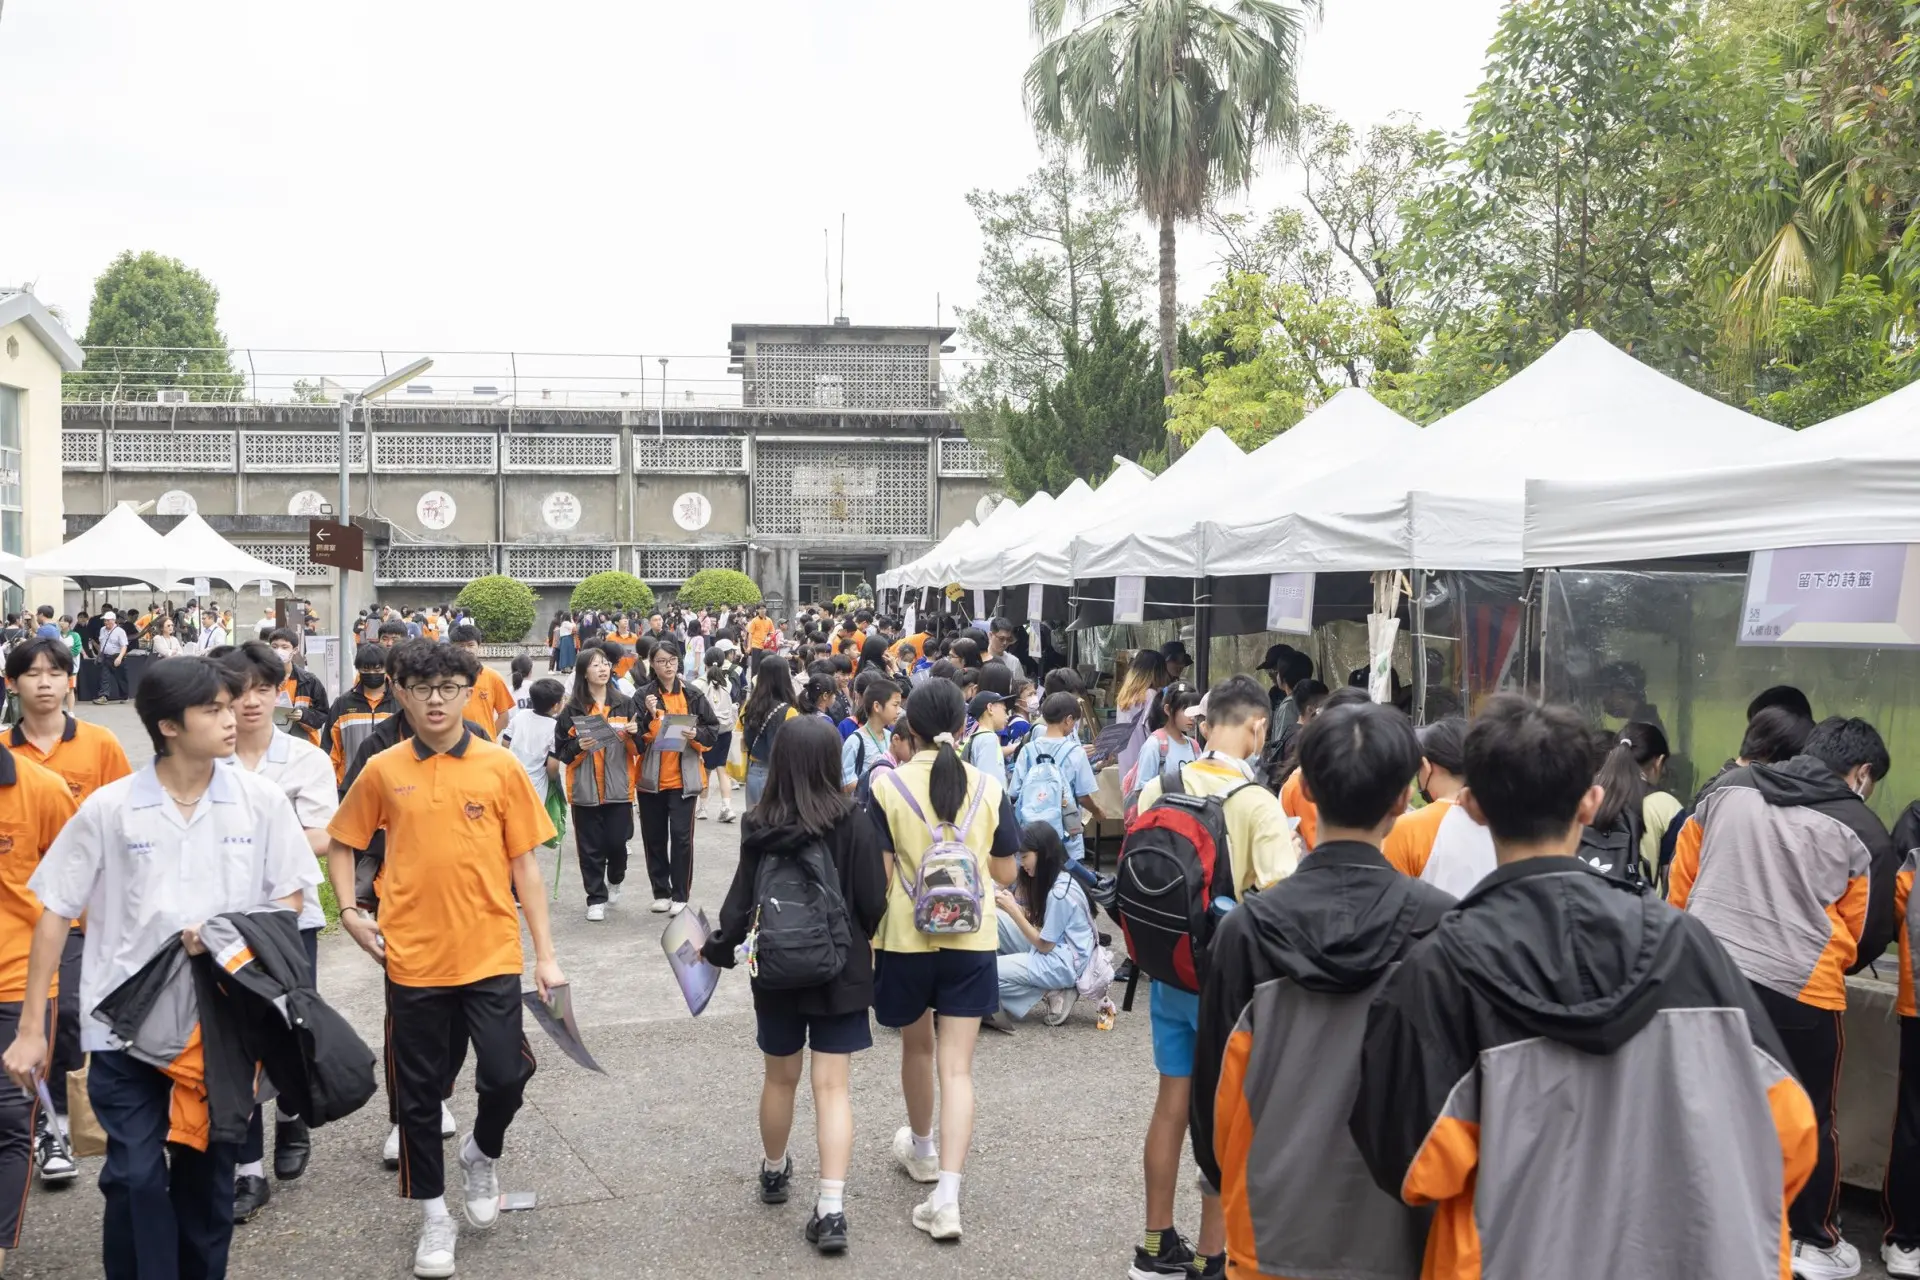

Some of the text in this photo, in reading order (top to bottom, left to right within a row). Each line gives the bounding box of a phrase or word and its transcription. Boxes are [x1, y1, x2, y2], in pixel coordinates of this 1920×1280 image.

[1798, 571, 1873, 588] 留下的詩籤
